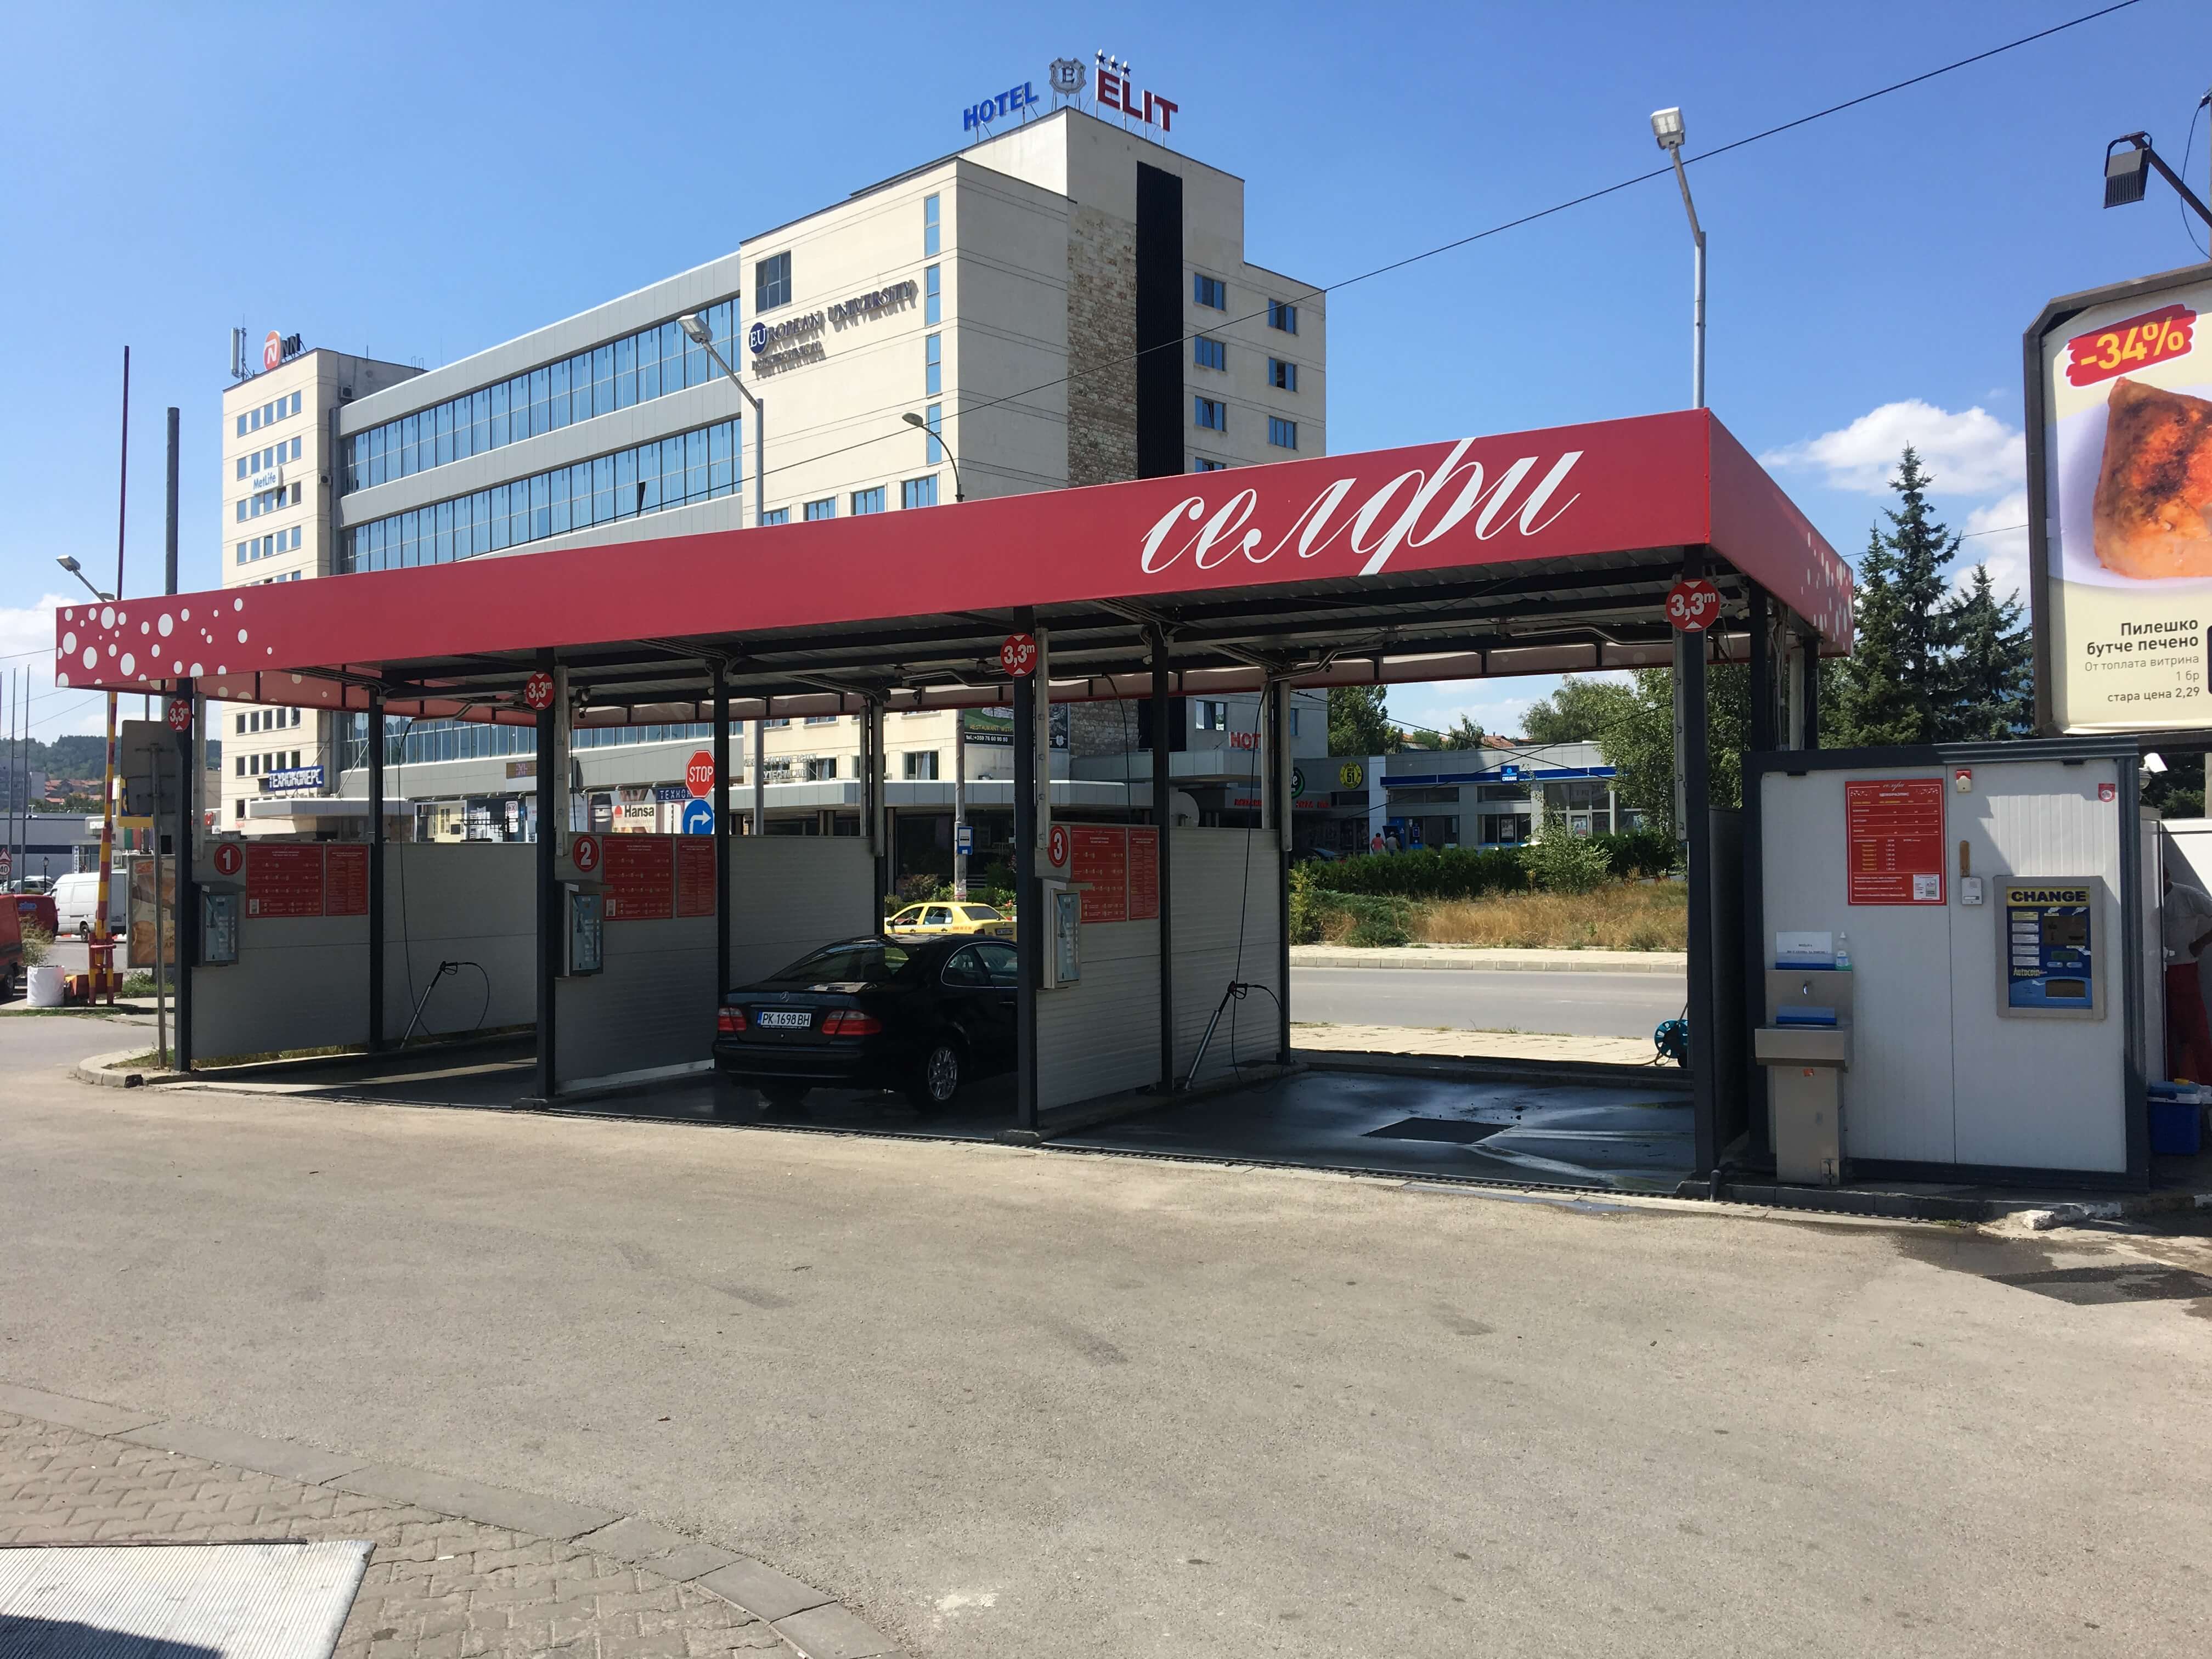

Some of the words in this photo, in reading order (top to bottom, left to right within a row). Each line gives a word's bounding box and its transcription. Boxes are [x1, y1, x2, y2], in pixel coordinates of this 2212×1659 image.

[1061, 67, 1075, 83] E
[964, 81, 1039, 132] HOTEL
[1097, 68, 1178, 132] ELIT
[749, 311, 825, 348] EUROPEAN
[827, 280, 918, 323] UNIVERSITY
[2080, 316, 2184, 369] -34%
[253, 472, 276, 490] MetLife
[1140, 437, 1584, 577] селфи
[2121, 619, 2198, 636] Пилешко
[2087, 641, 2133, 658] бутче
[2138, 636, 2199, 651] печено
[2085, 662, 2098, 672] От
[2102, 659, 2147, 670] топлата
[2151, 656, 2199, 668] витрина
[2176, 672, 2181, 680] 1
[2186, 670, 2199, 682] бр
[2108, 691, 2140, 703] стара
[2144, 690, 2172, 701] цена
[2176, 687, 2200, 699] 2,29
[1229, 732, 1261, 749] HOT
[689, 766, 714, 782] STOP
[624, 805, 654, 817] Hansa
[580, 842, 591, 865] 2
[1054, 833, 1062, 859] 3
[222, 849, 232, 870] 1
[2011, 891, 2086, 902] CHANGE
[763, 1013, 774, 1024] PK
[777, 1014, 796, 1025] 1698
[797, 1014, 809, 1025] BH
